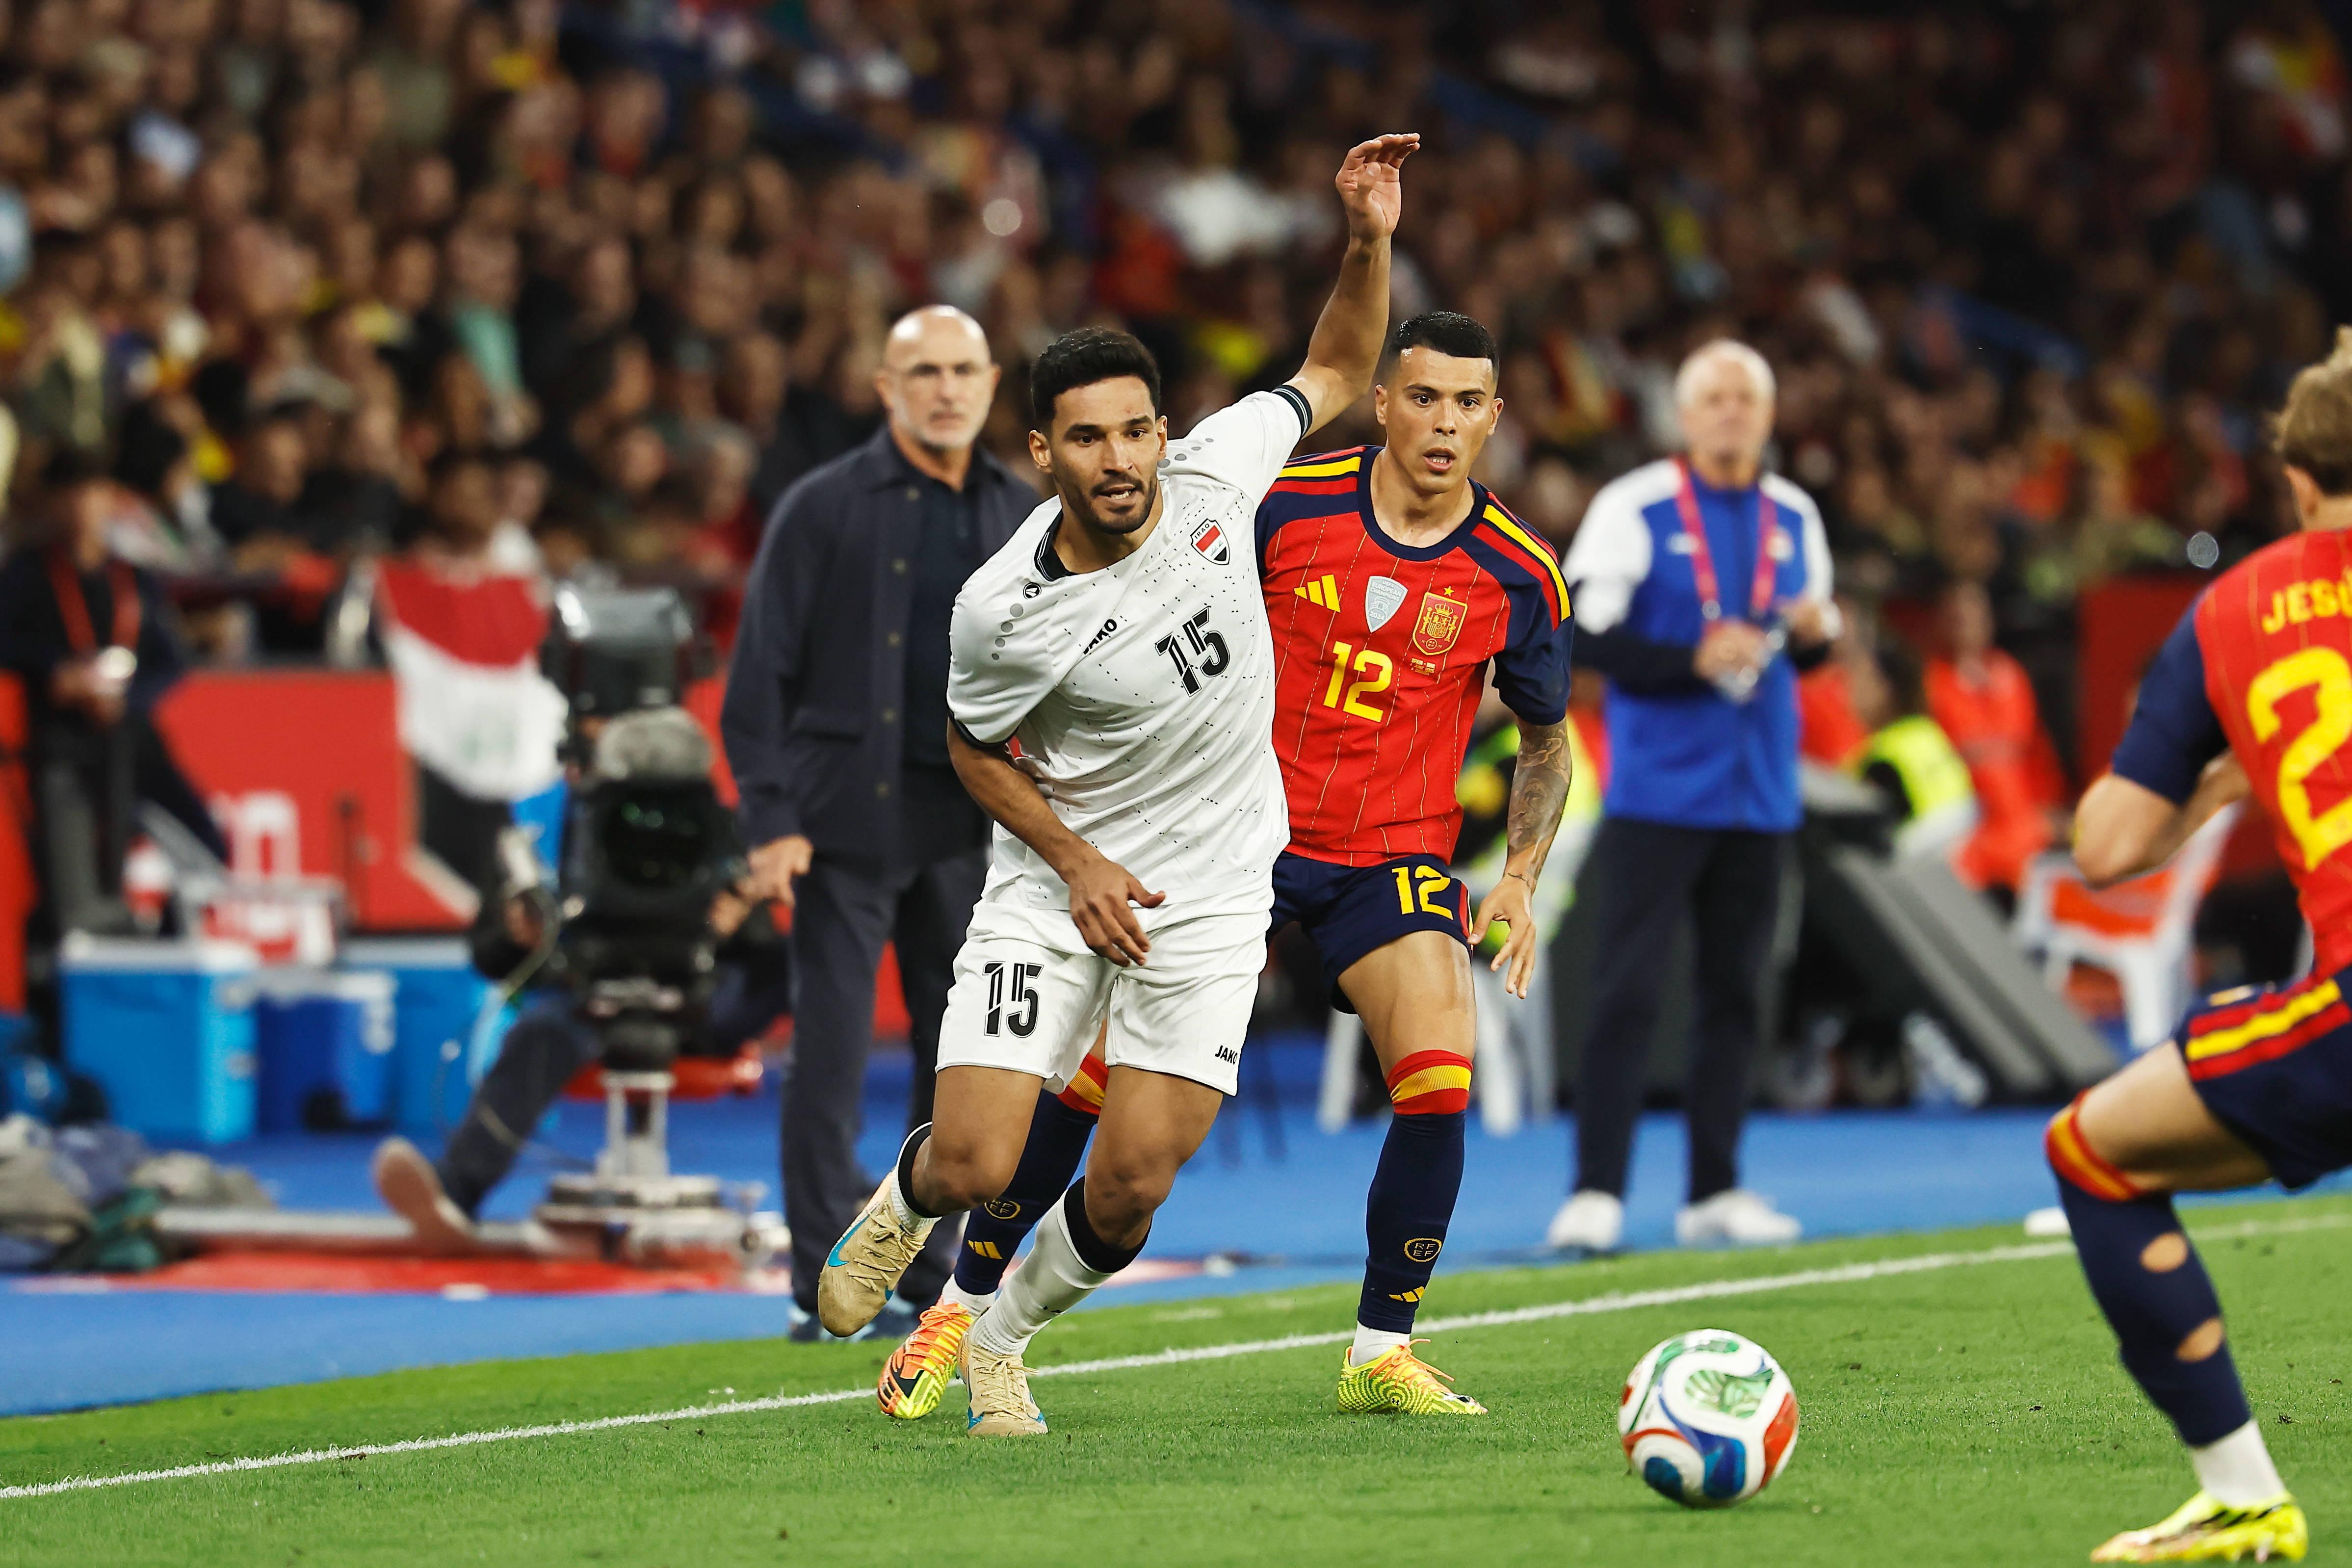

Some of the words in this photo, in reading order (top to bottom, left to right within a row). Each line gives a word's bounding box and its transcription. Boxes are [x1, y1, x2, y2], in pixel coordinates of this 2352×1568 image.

[1194, 523, 1210, 539] IRAQ
[1370, 587, 1400, 602] CHAMPIONS
[1371, 581, 1402, 597] EUROPEAN
[1155, 606, 1230, 697] 15
[1323, 641, 1393, 723] 12
[2247, 646, 2352, 872] 2
[1391, 865, 1454, 920] 12
[982, 961, 1044, 1039] 15
[1215, 1045, 1238, 1065] JAKO
